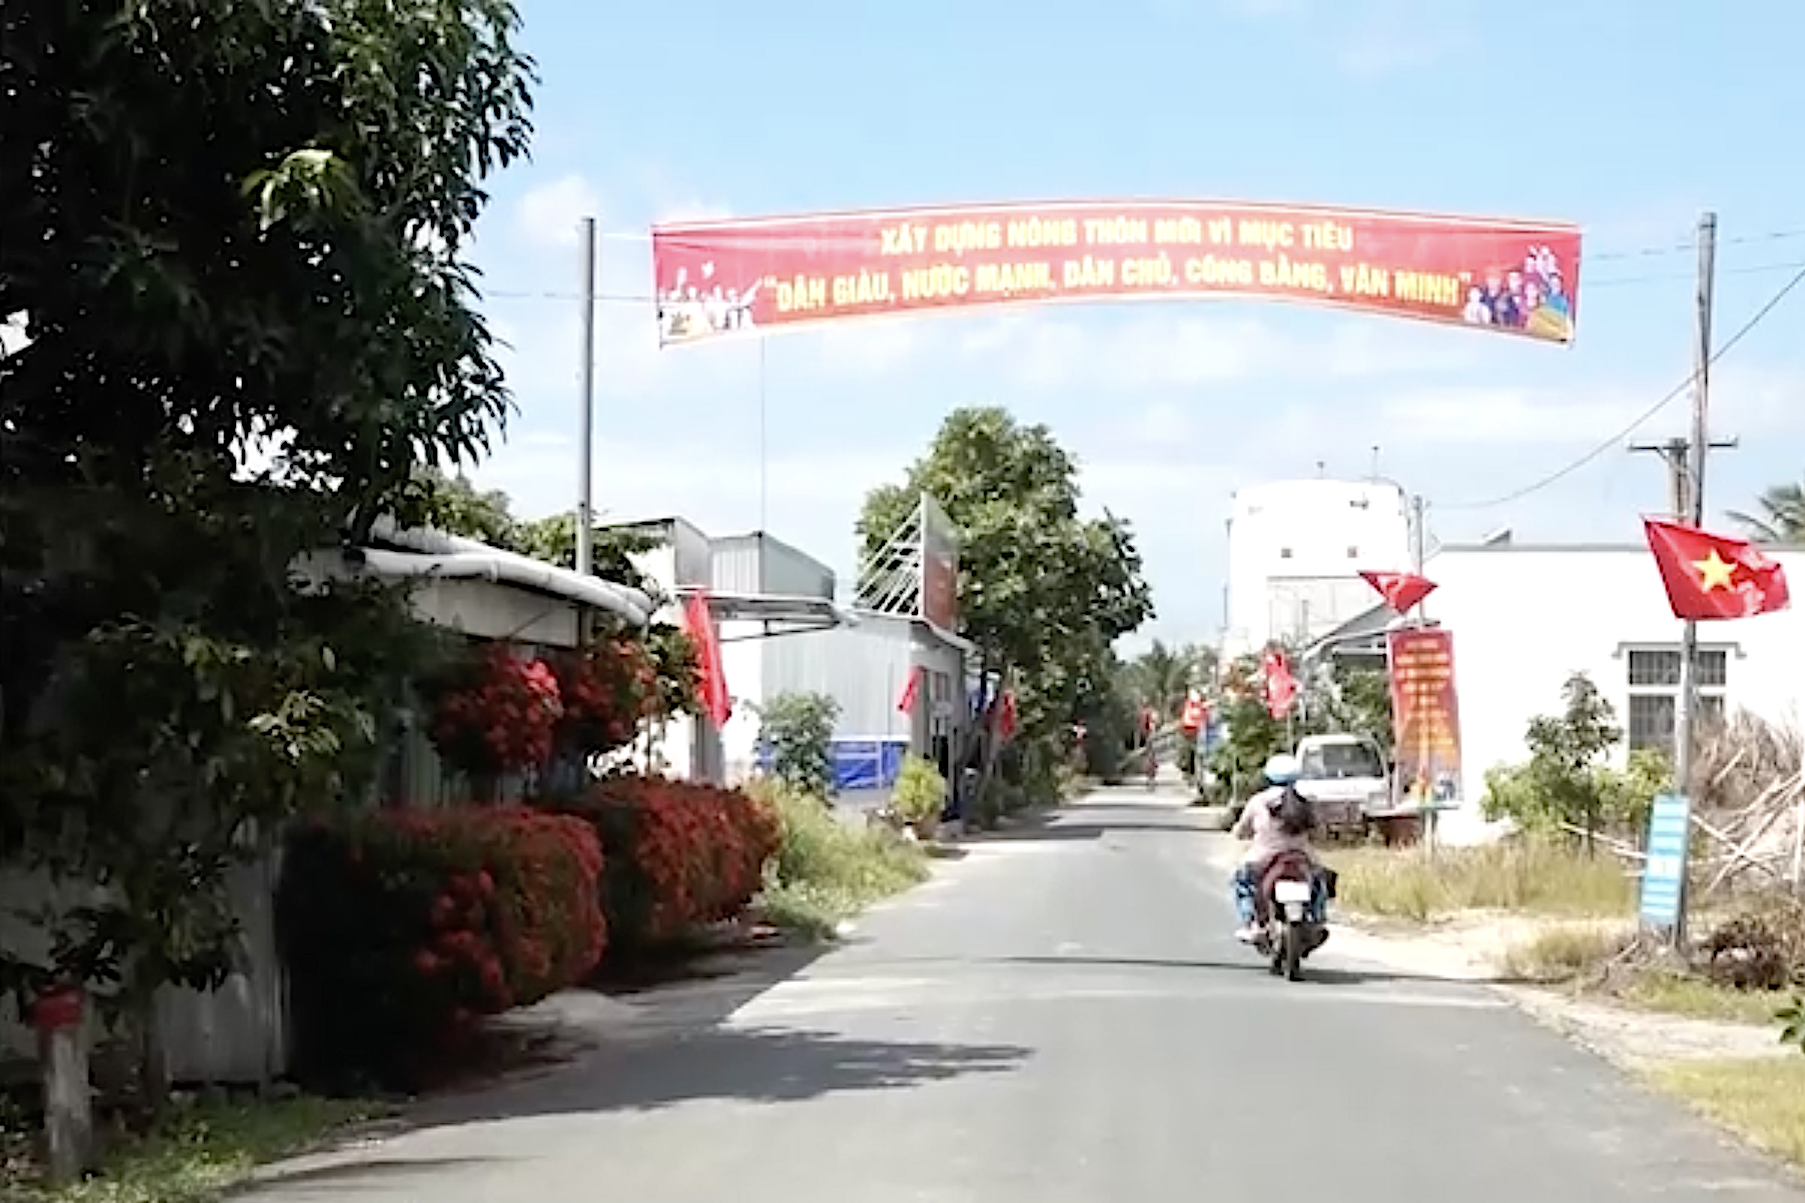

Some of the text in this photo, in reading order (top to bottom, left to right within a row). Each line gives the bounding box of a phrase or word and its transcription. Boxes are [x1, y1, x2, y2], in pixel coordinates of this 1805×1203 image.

[1007, 215, 1077, 247] NÔNG
[1083, 215, 1147, 244] THÔN
[1239, 218, 1294, 252] MỤC
[1300, 221, 1353, 251] TIÊU
[1063, 254, 1114, 288] DÂN
